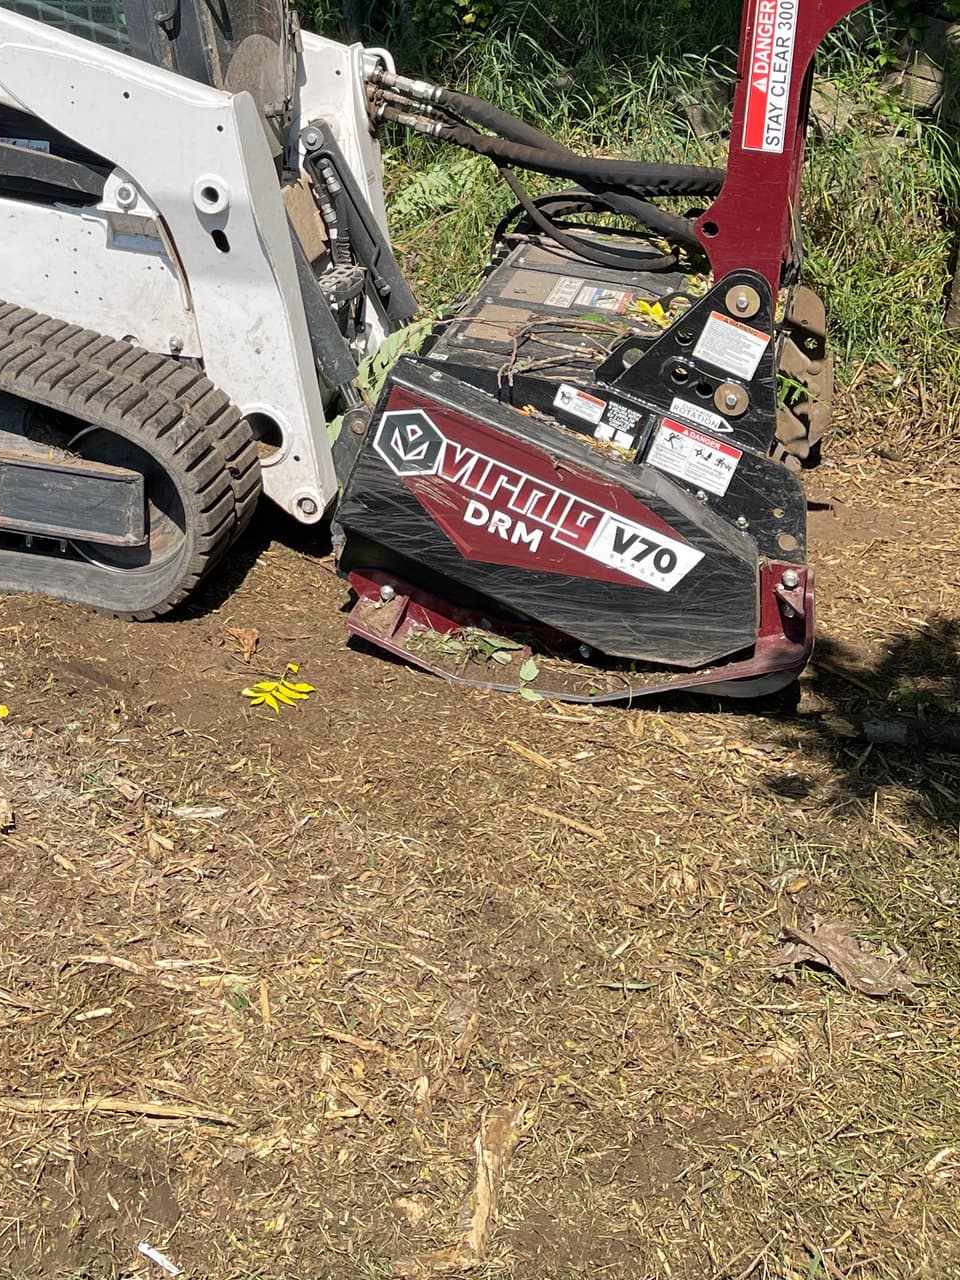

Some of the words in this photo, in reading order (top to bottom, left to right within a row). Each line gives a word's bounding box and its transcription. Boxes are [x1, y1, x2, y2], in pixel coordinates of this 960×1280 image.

[755, 1, 775, 74] DANGER
[778, 1, 794, 31] 300
[771, 37, 791, 97] CLEAR
[766, 104, 784, 146] STAY
[673, 405, 718, 429] ROTATION
[690, 432, 721, 450] DANGER
[462, 499, 544, 553] DRM
[612, 525, 678, 574] V70
